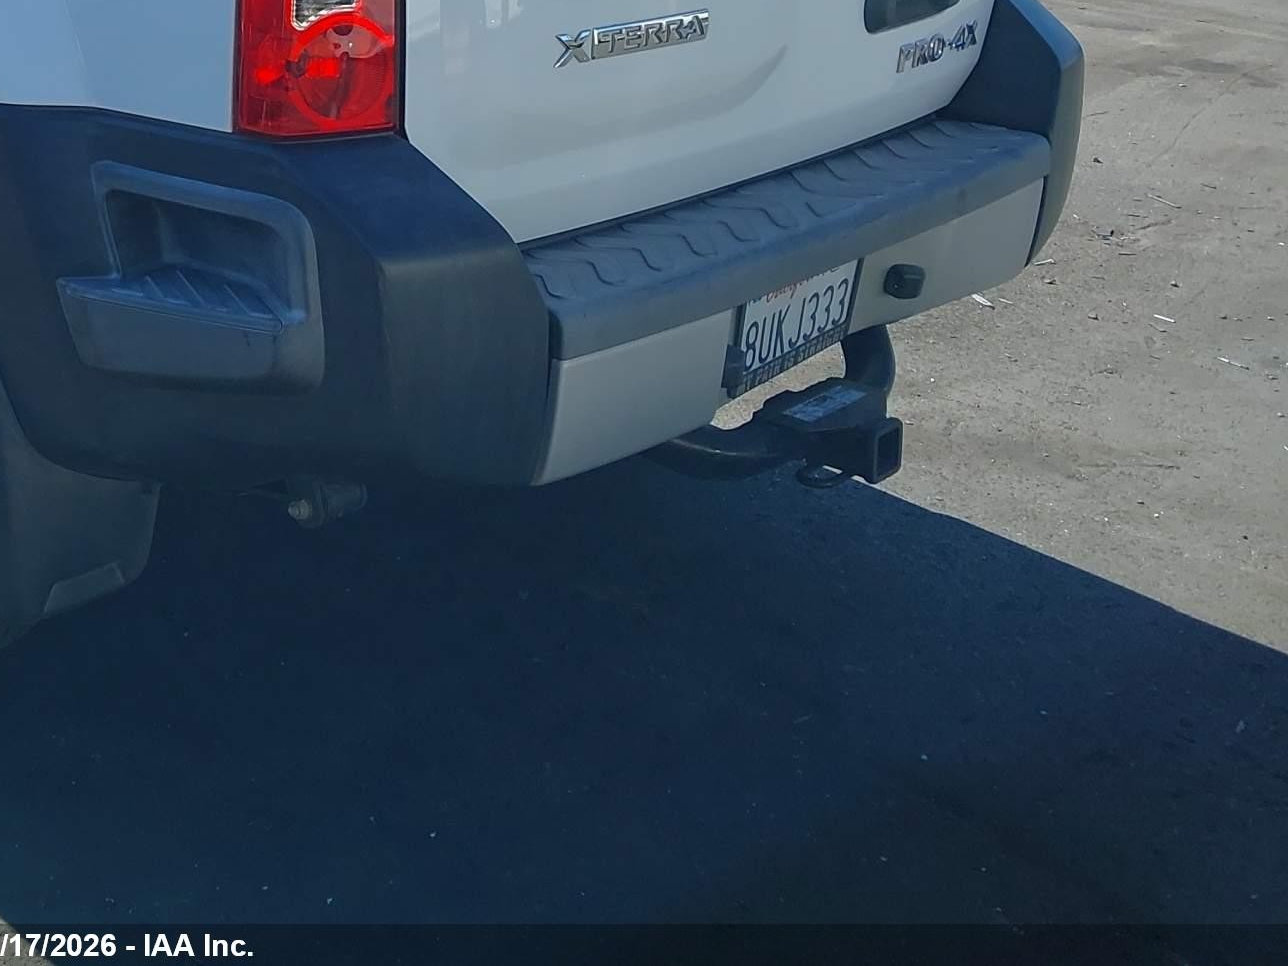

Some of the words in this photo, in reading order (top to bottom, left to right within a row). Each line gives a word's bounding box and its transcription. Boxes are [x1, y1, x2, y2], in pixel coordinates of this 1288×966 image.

[553, 8, 709, 68] XTERRA
[896, 19, 978, 73] PRO-4X
[744, 278, 849, 371] 8UKJ333
